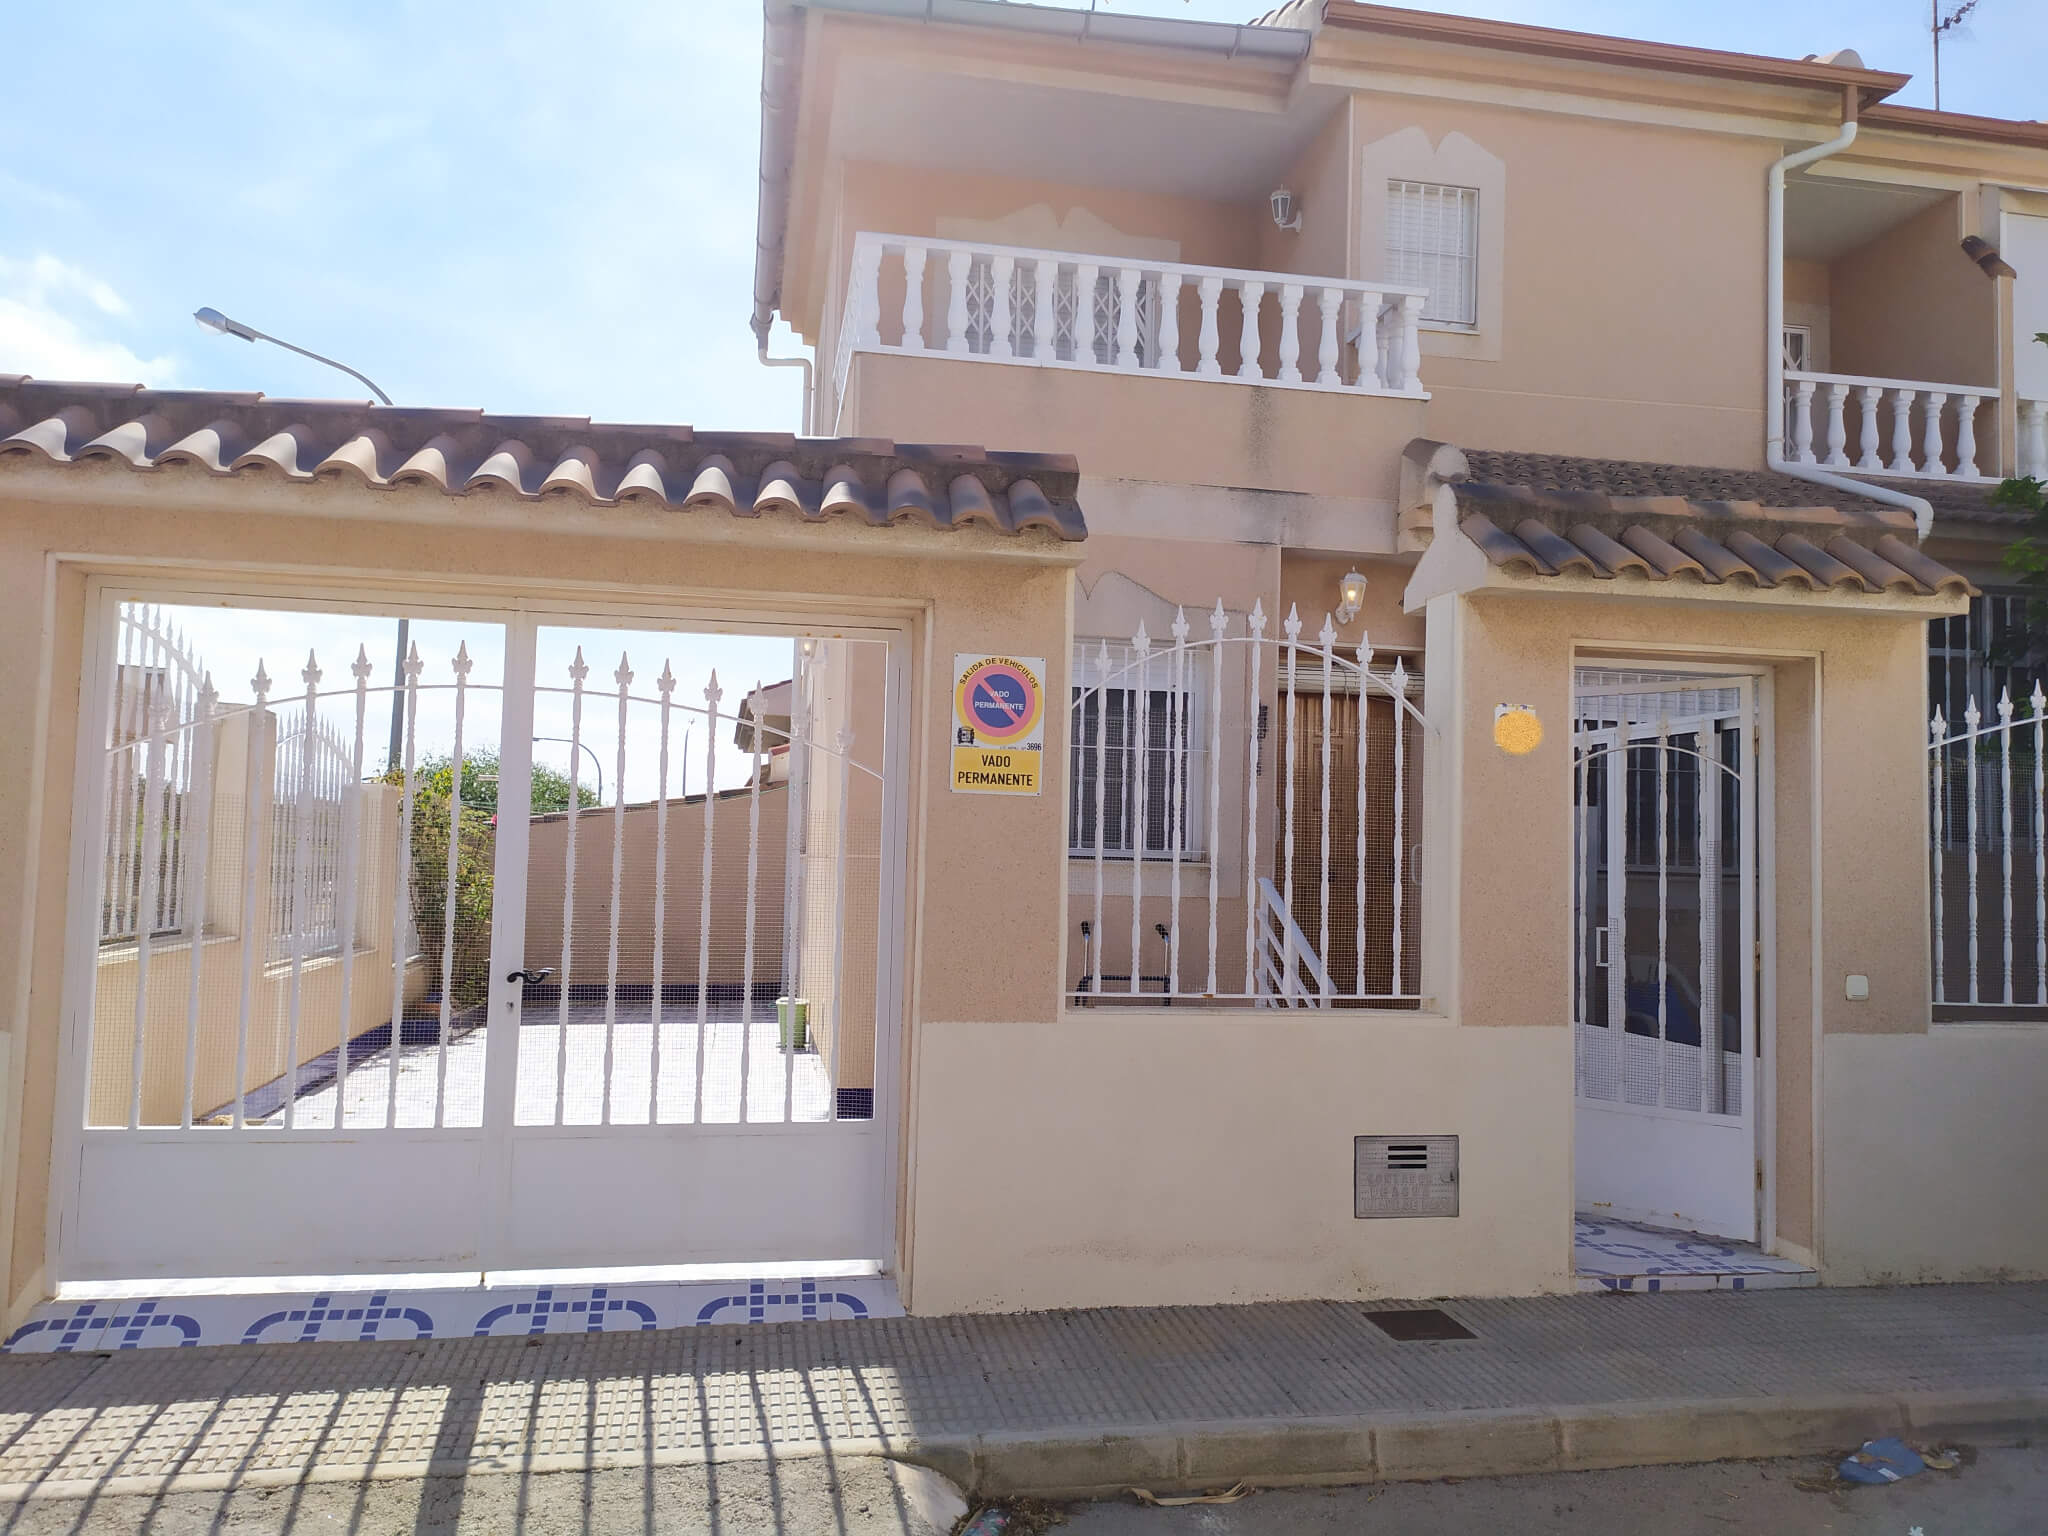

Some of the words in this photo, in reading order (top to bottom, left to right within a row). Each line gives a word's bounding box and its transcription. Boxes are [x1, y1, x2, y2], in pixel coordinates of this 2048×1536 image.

[959, 661, 985, 685] SALIDA
[985, 657, 997, 665] DE
[998, 657, 1039, 689] VEHICULOS
[990, 690, 1010, 698] VADO
[974, 701, 1025, 711] PERMANENTE
[981, 754, 1011, 768] VADO
[958, 771, 1033, 787] PERMANENTE
